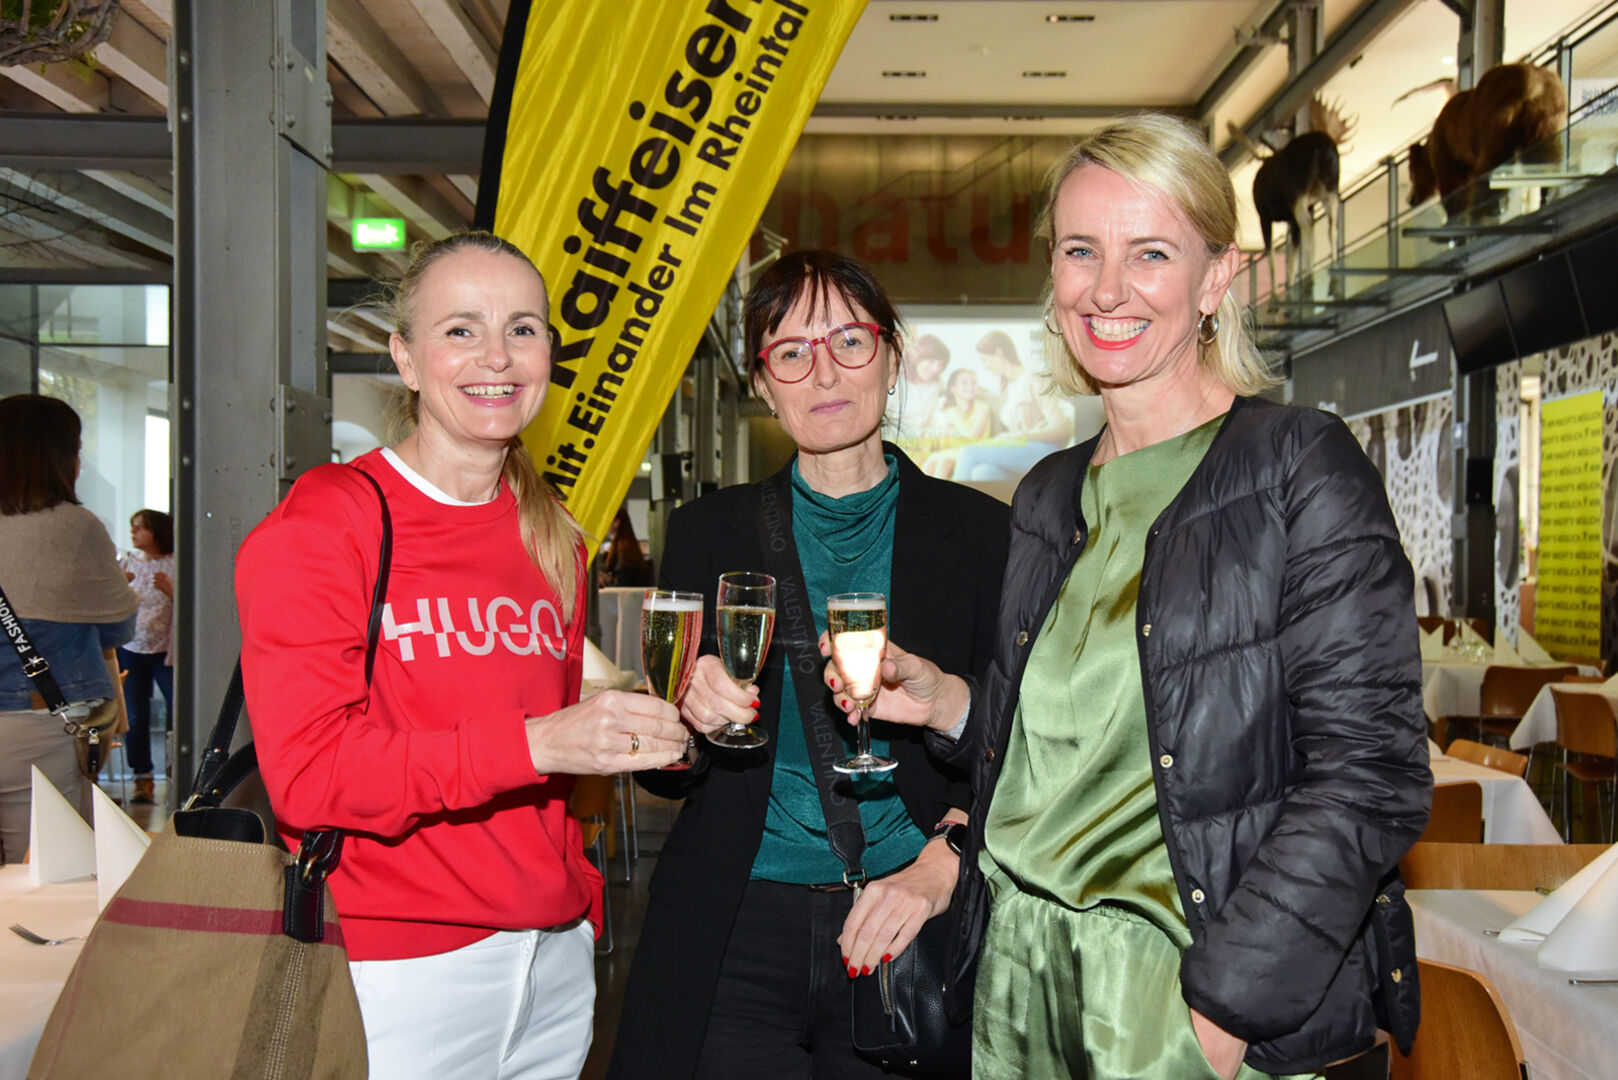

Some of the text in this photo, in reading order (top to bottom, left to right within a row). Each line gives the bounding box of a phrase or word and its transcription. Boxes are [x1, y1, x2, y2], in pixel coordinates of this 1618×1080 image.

[549, 0, 762, 389] Raiffeisen
[664, 181, 717, 236] Im
[696, 0, 809, 171] Rheintal
[752, 191, 1050, 265] natu
[381, 596, 567, 661] HUGO
[761, 479, 786, 552] ALENTINO
[780, 576, 815, 673] VALENTINO
